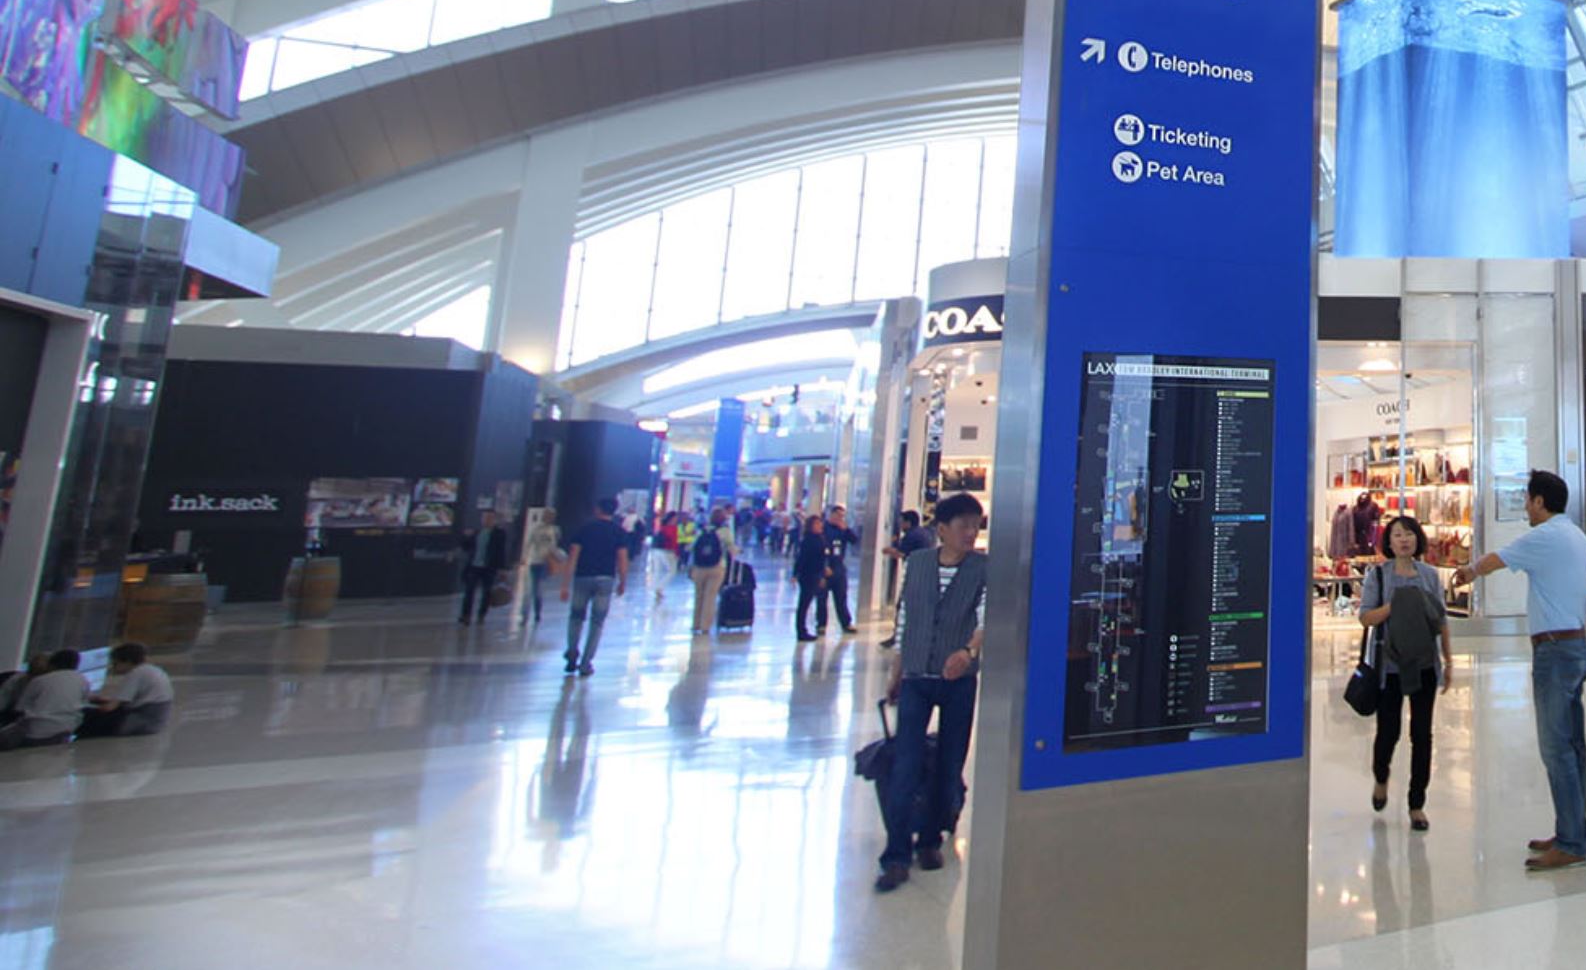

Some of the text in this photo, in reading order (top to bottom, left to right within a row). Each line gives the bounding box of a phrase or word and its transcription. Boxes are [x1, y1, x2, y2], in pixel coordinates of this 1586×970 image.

[1152, 52, 1253, 83] Telephones
[1149, 124, 1232, 154] Ticketing
[1147, 161, 1225, 186] Pet Area
[923, 304, 1005, 339] COA
[1088, 361, 1114, 375] LAX
[169, 493, 278, 511] ink.sack
